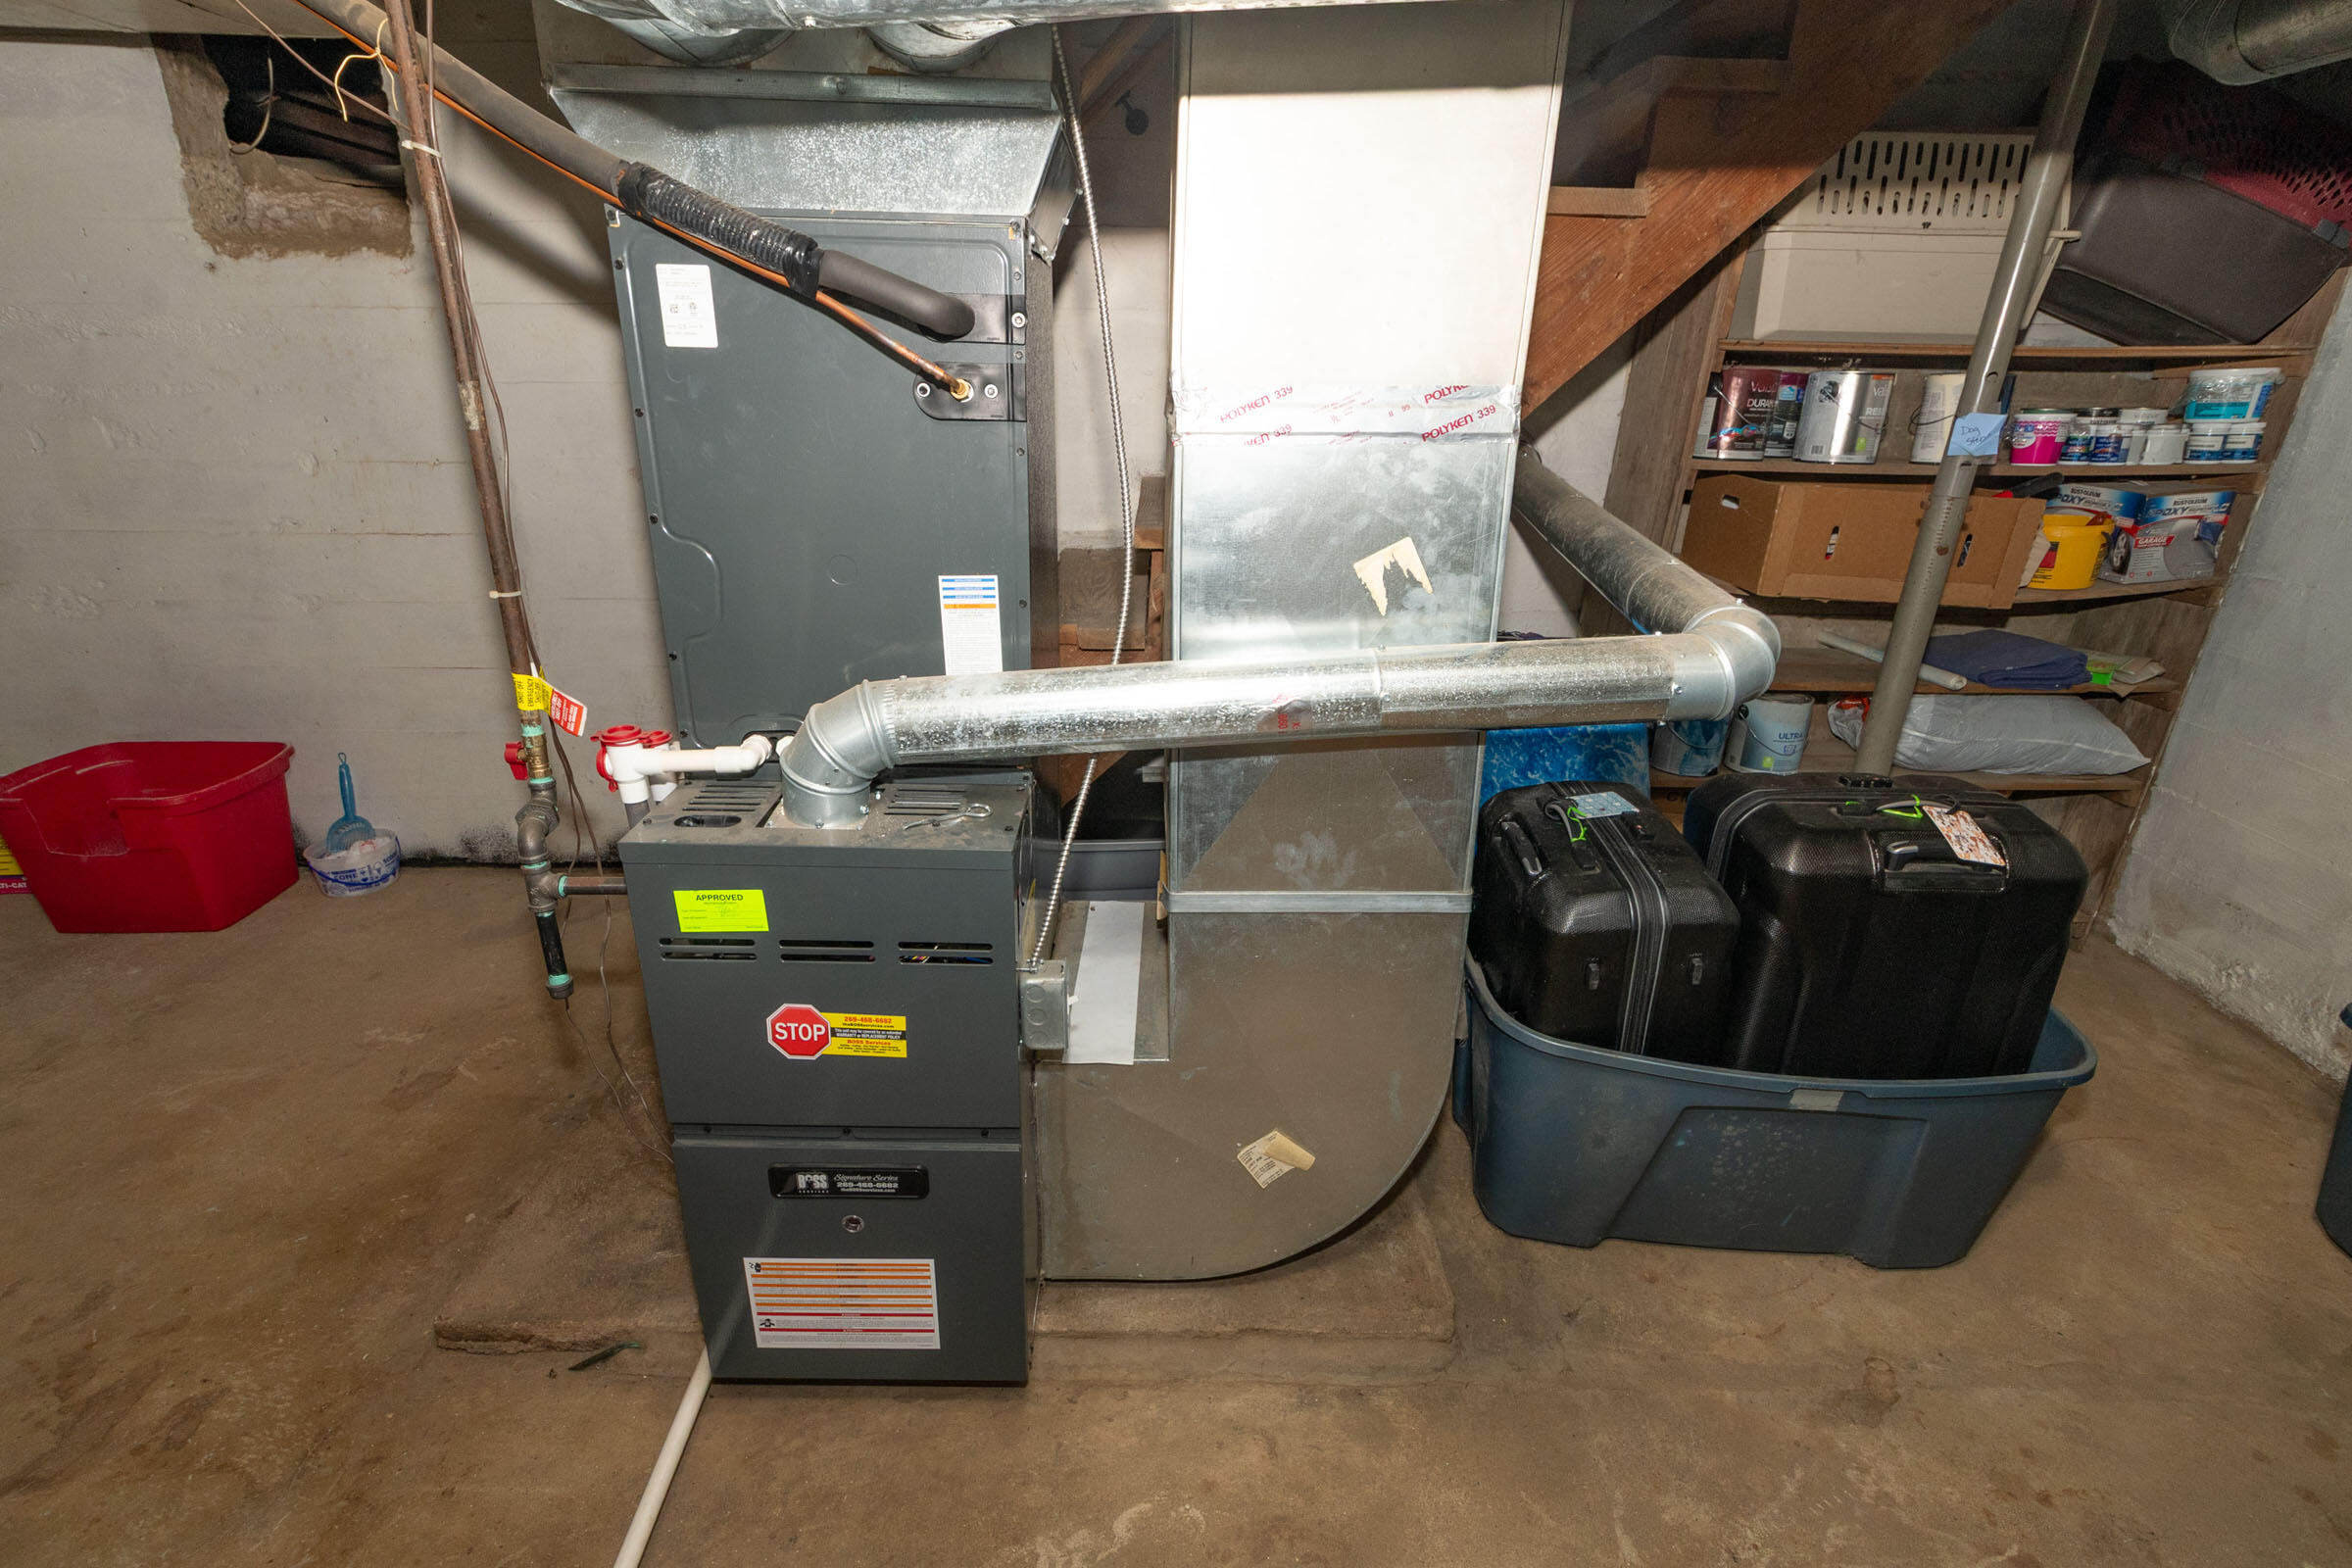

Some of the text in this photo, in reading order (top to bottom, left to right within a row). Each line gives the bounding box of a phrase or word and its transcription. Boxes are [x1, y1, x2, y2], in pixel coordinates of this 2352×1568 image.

[1219, 385, 1294, 422] POLYKEN 339
[1421, 405, 1496, 442] POLYKEN 339
[2070, 488, 2101, 498] RUST-OLEUM
[774, 1022, 826, 1042] STOP
